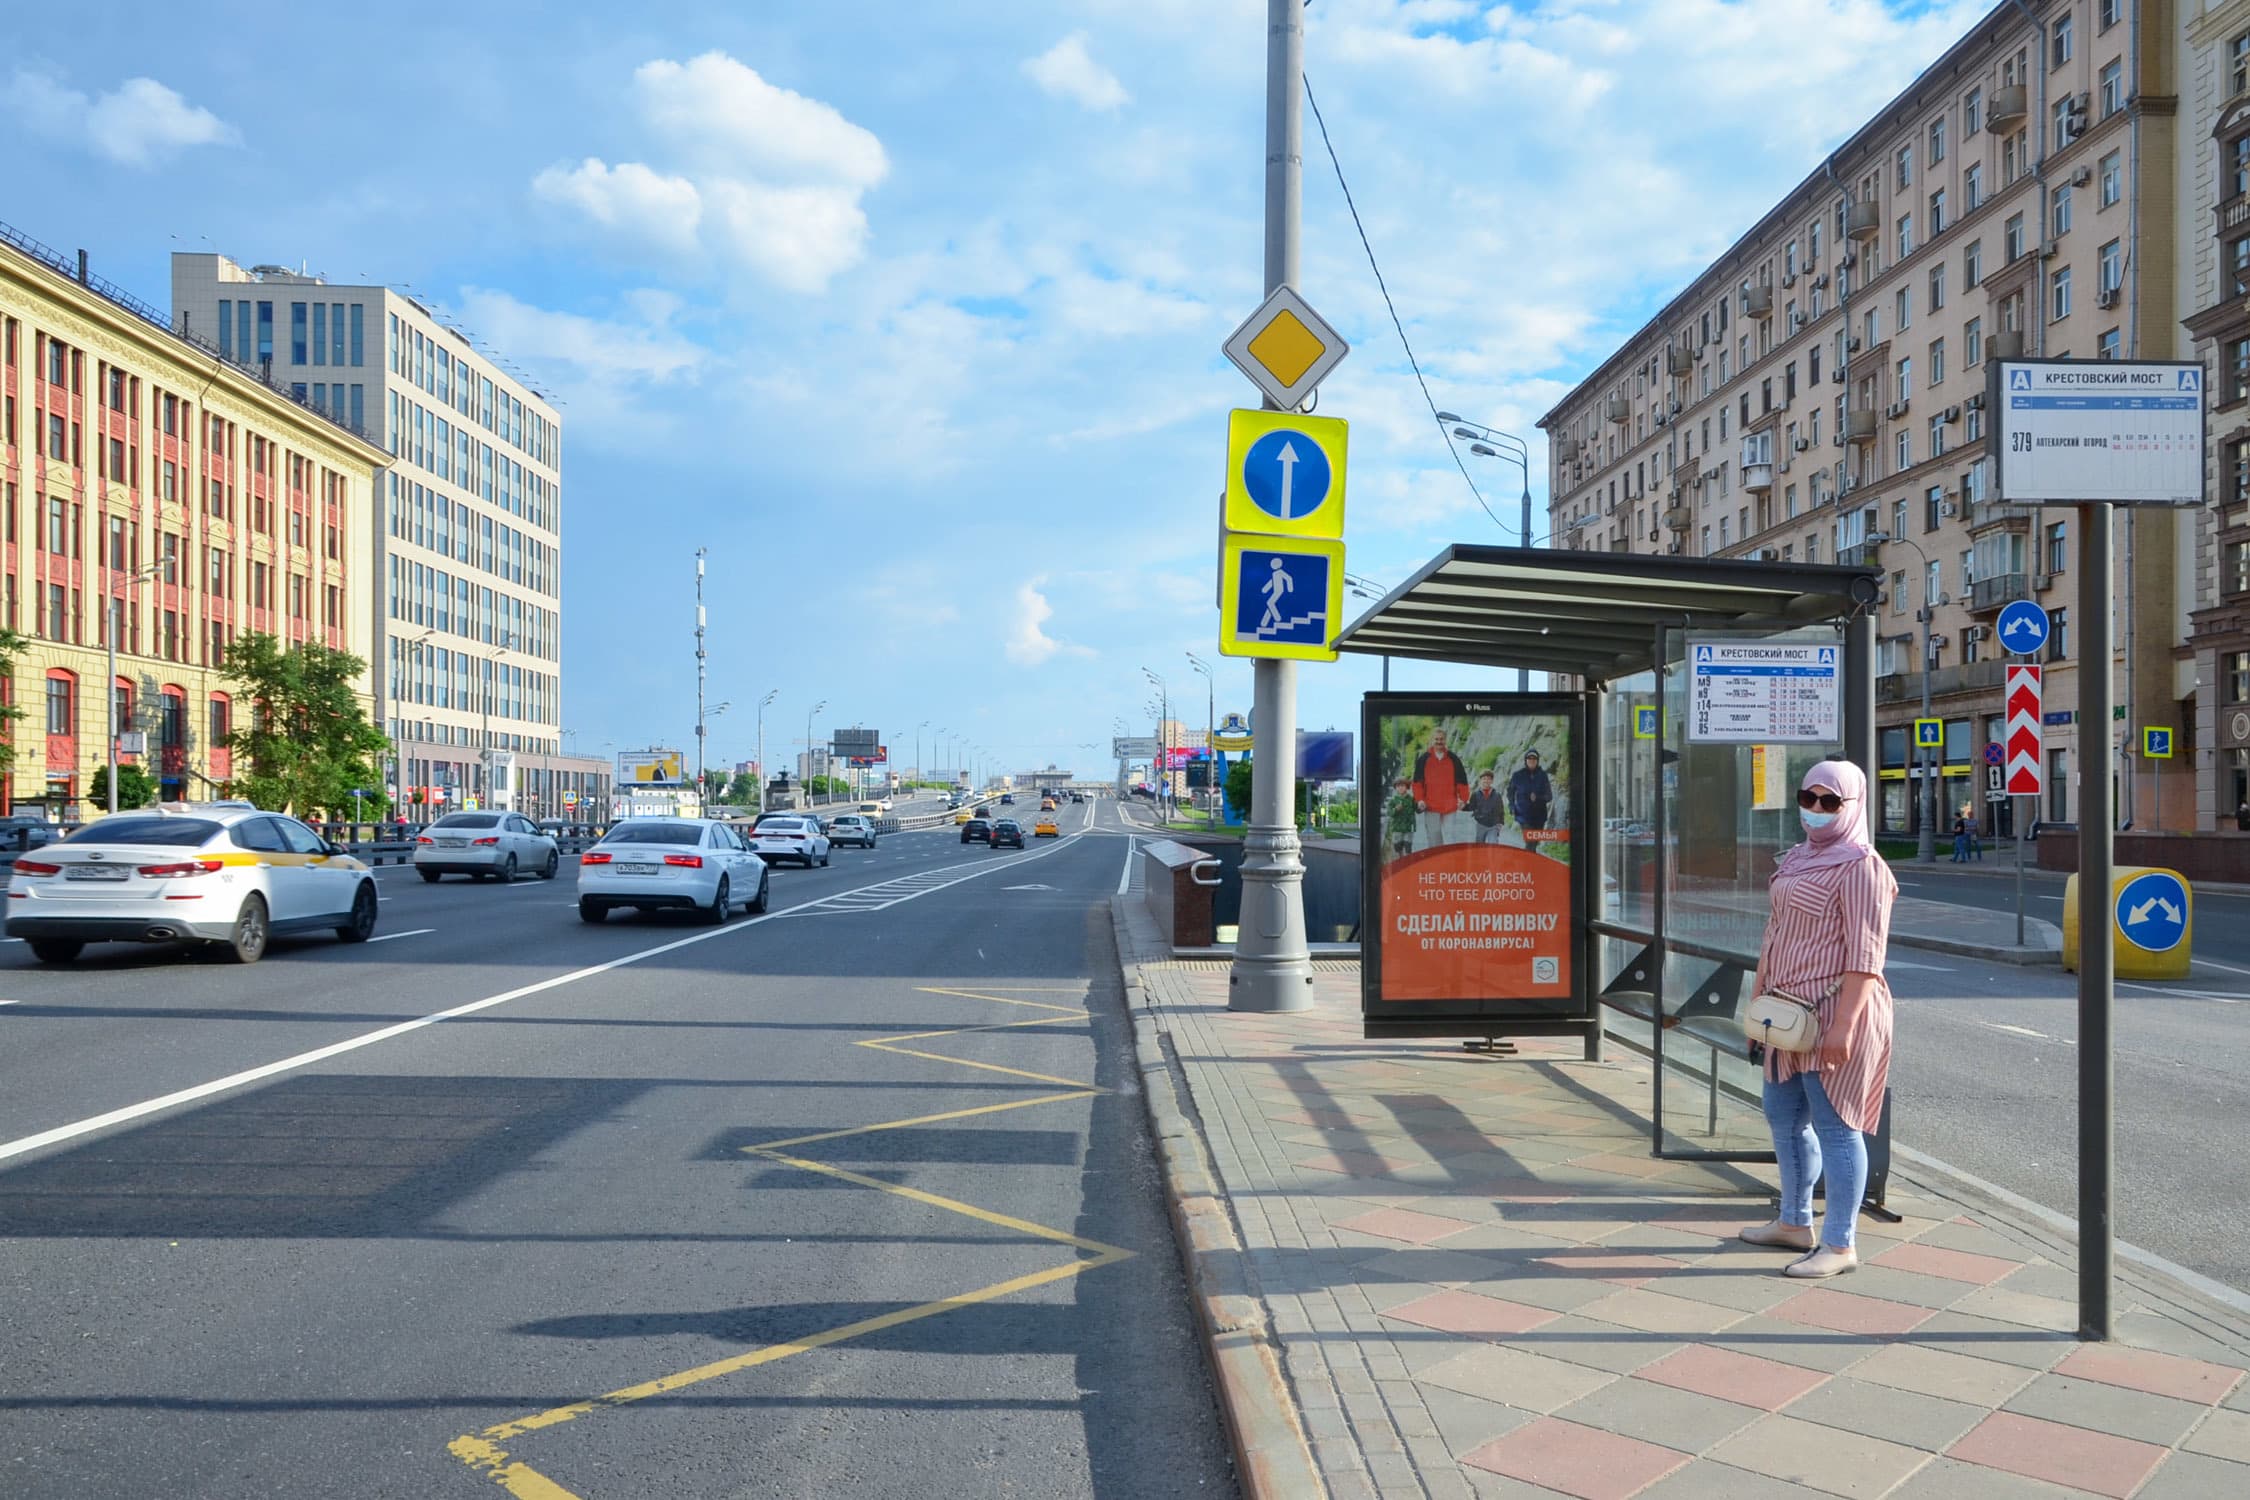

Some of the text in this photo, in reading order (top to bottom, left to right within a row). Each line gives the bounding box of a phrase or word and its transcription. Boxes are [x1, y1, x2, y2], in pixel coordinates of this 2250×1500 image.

[2045, 371, 2127, 385] КРЕСТОВСКИЙ
[2130, 373, 2164, 385] МОСТ
[2012, 431, 2032, 453] 379
[2035, 436, 2080, 448] АПТЕКАРСКИЙ
[2083, 437, 2108, 449] ОГОРОД
[1720, 647, 1783, 659] КРЕСТОВСКИЙ
[1784, 649, 1809, 660] МОСТ
[1698, 711, 1709, 723] 33
[1526, 831, 1558, 841] СЕМЬЯ
[1418, 870, 1535, 886] НЕ РИСКУЙ ВСЕМ,
[1418, 889, 1535, 903] ЧТО ТЕБЕ ДОРОГО
[1397, 911, 1558, 935] СДЕЛАЙ ПРИВИВКУ
[1420, 937, 1535, 950] ОТ КОРОНАВИРУСА!
